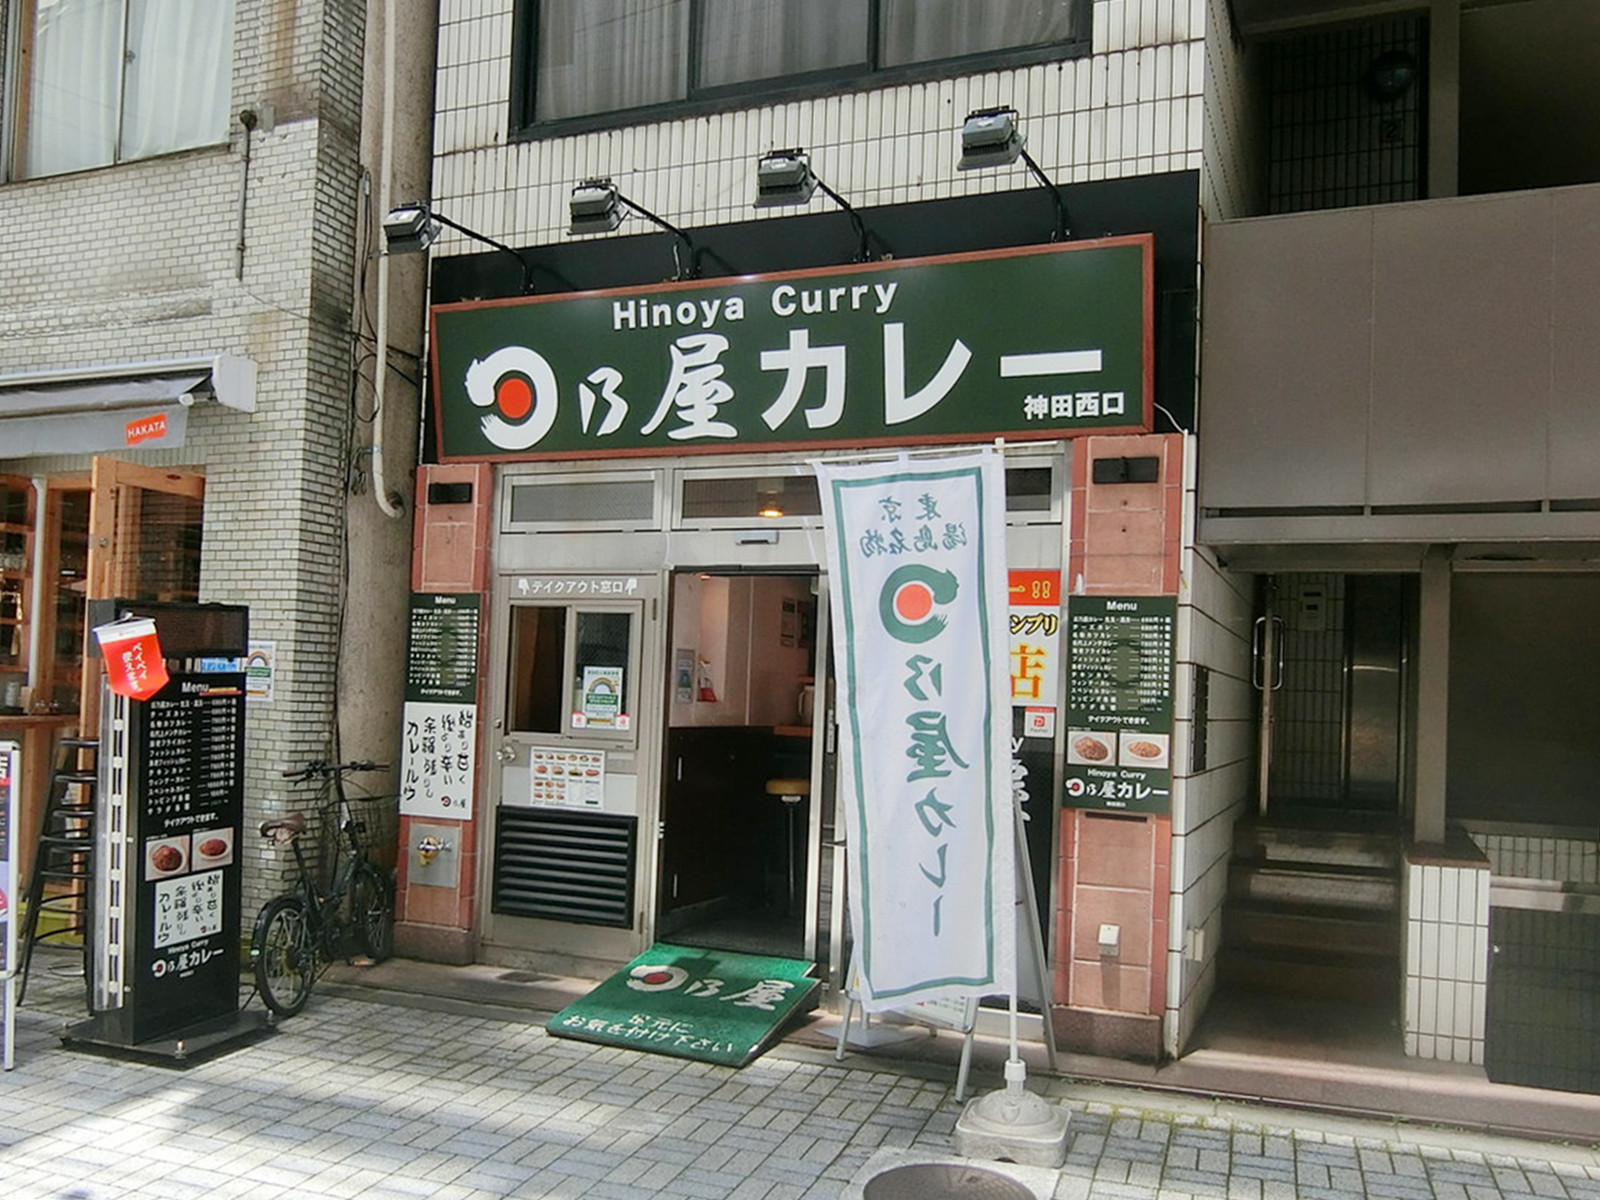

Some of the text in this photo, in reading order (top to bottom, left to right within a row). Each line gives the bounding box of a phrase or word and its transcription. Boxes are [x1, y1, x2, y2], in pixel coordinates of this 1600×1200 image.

[613, 282, 899, 330] Hinoya Curry
[1024, 391, 1125, 420] 神田西口
[127, 420, 167, 439] HAKATA
[531, 580, 624, 594] テイクアウト窓口
[434, 596, 457, 605] Menu
[1106, 601, 1138, 611] Menu
[132, 641, 148, 680] ペイペイ
[181, 682, 209, 693] Menu
[403, 721, 420, 801] カレールウ
[1087, 768, 1146, 780] Hinoya Curry
[628, 1014, 696, 1034] 足元に
[563, 1015, 733, 1053] お気を付け下さい
